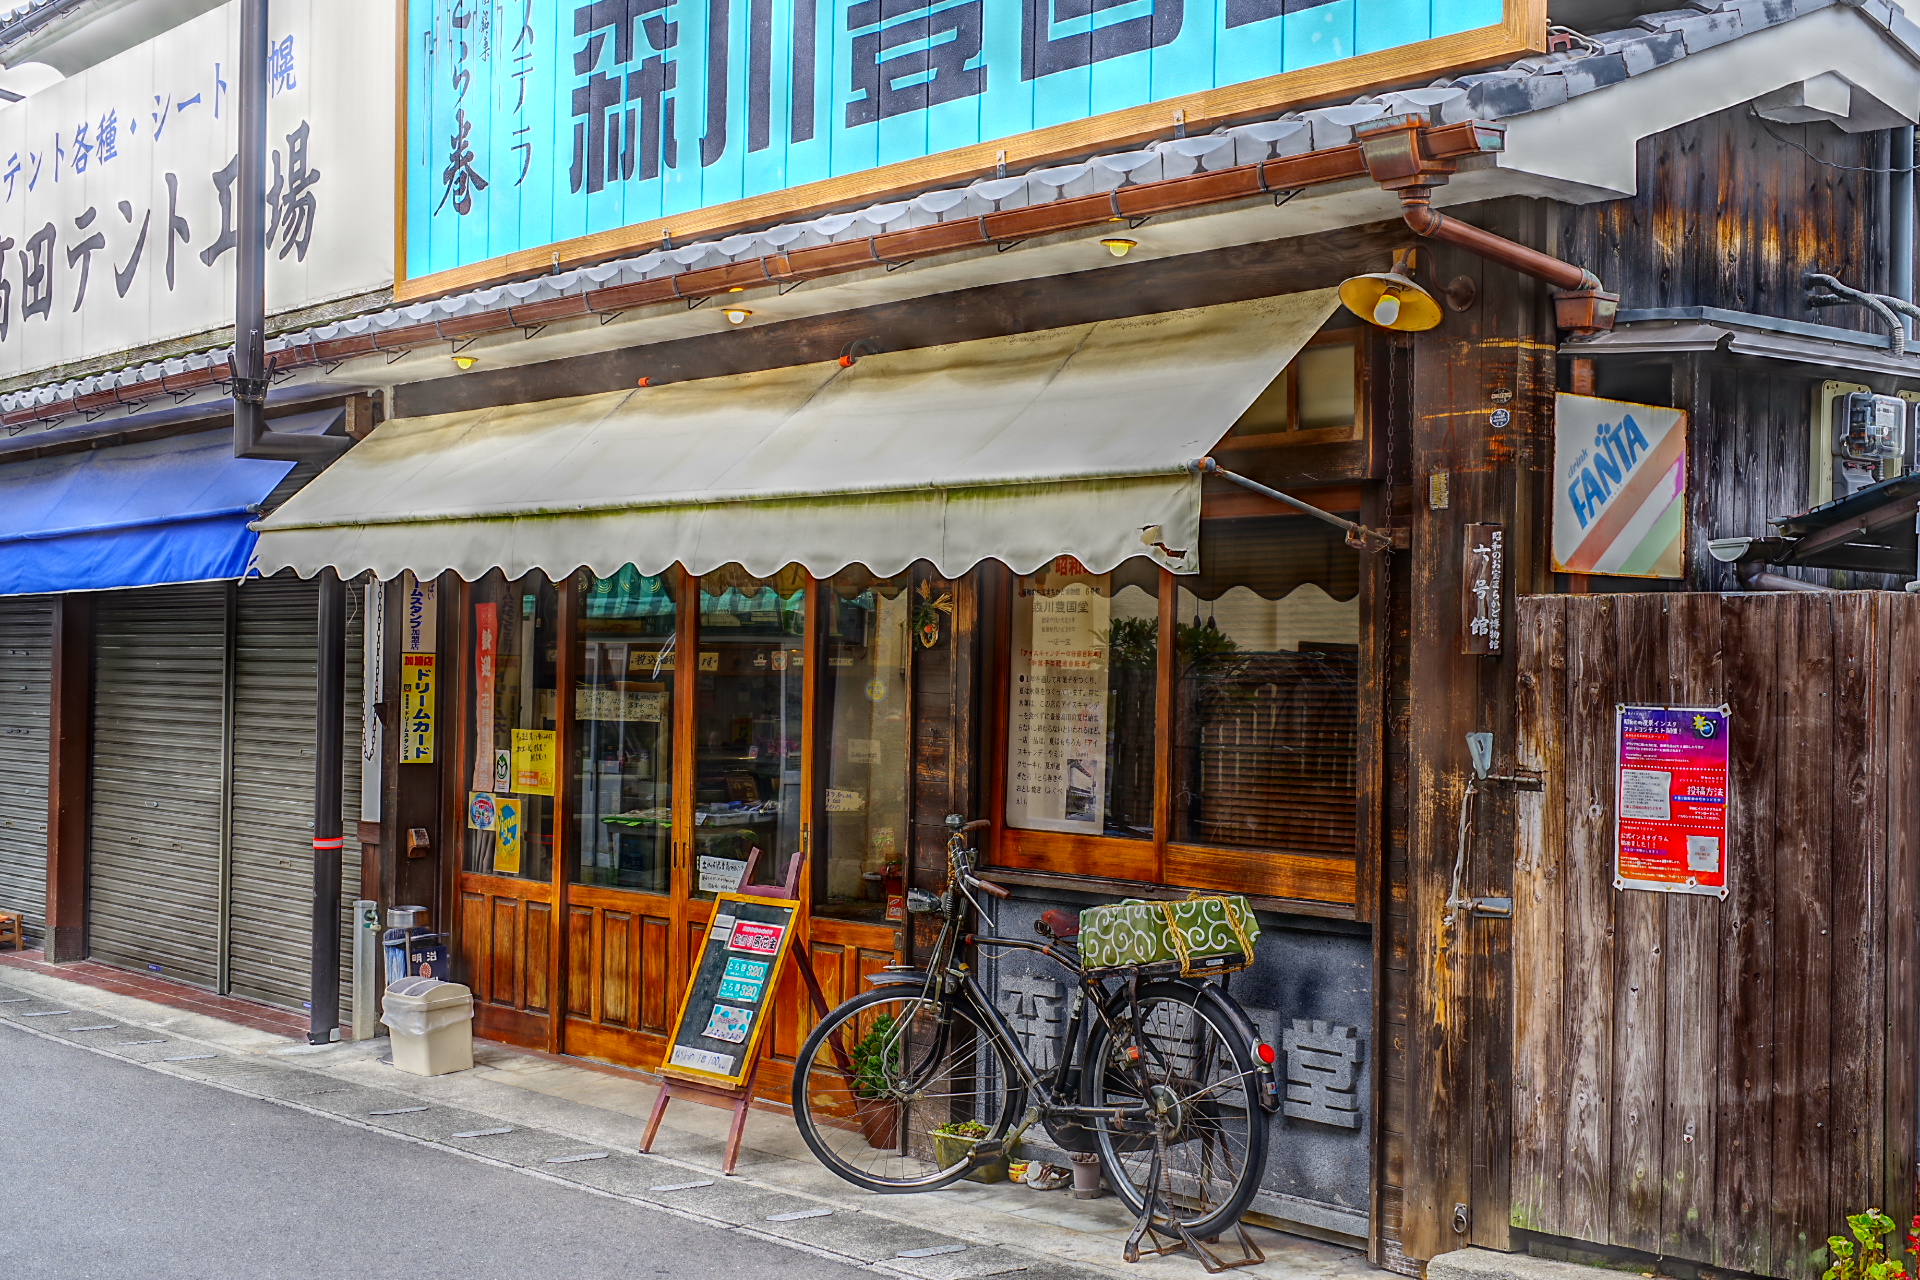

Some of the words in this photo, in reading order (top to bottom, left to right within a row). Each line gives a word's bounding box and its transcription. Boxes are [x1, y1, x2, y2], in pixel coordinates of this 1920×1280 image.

[1568, 448, 1588, 479] drink
[1568, 413, 1649, 530] FANTA
[1055, 556, 1092, 576] 昭和
[1470, 543, 1491, 636] 六号館
[1489, 531, 1502, 650] 昭和のお宝まちかど博物館
[409, 573, 424, 650] ームスタンプ加盟店
[1033, 600, 1089, 613] 森川豊国堂
[404, 655, 434, 667] 加盟店
[412, 668, 432, 759] ドリームカード
[1687, 785, 1724, 797] 投稿方法
[411, 950, 437, 964] 明治
